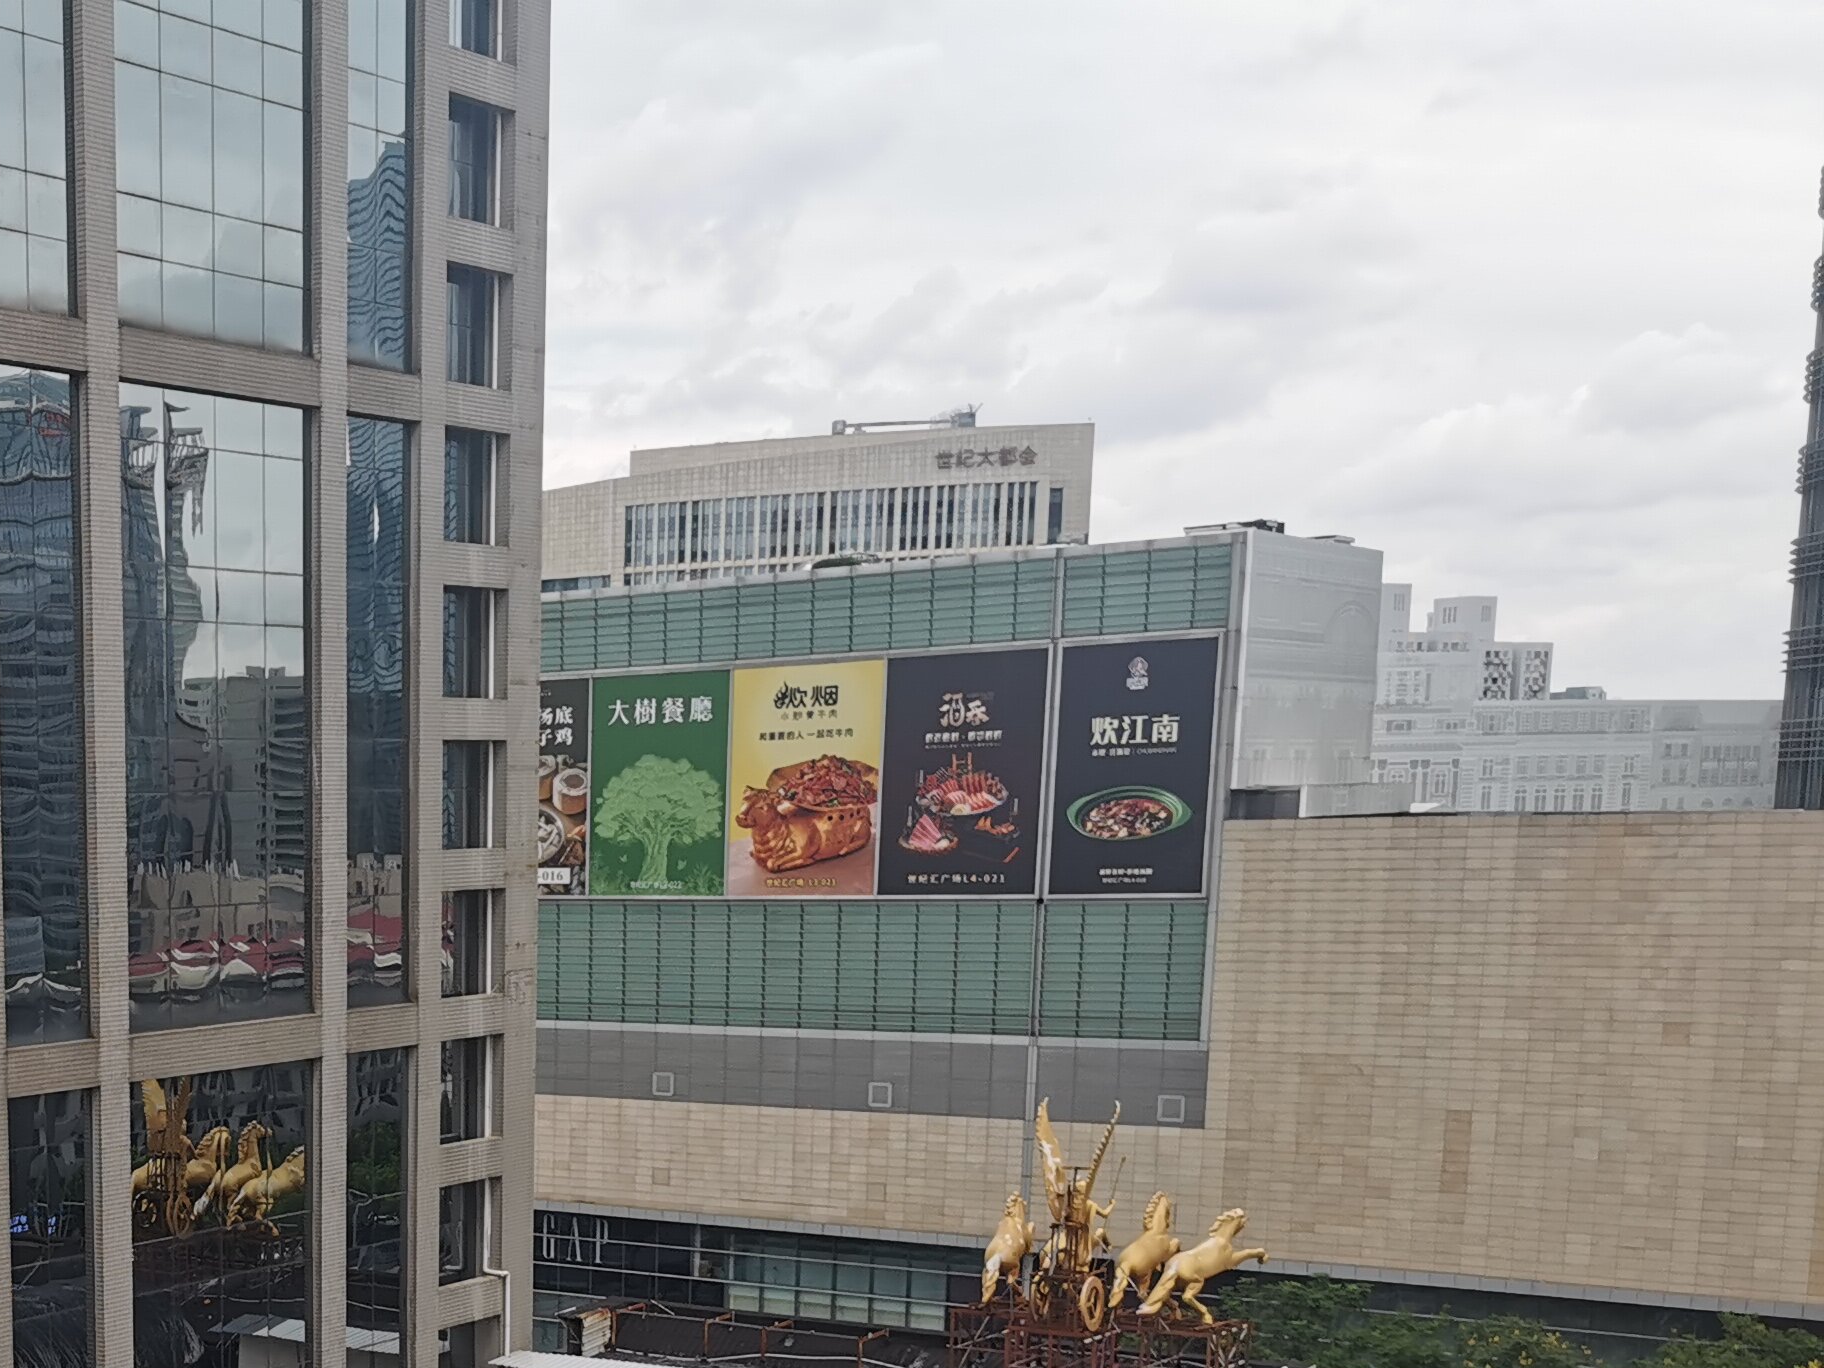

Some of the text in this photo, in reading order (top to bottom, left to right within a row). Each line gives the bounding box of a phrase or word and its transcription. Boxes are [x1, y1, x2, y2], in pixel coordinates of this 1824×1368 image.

[608, 695, 714, 726] 大樹餐廳
[1089, 713, 1181, 746] 炊江南
[542, 1213, 609, 1264] GAP
